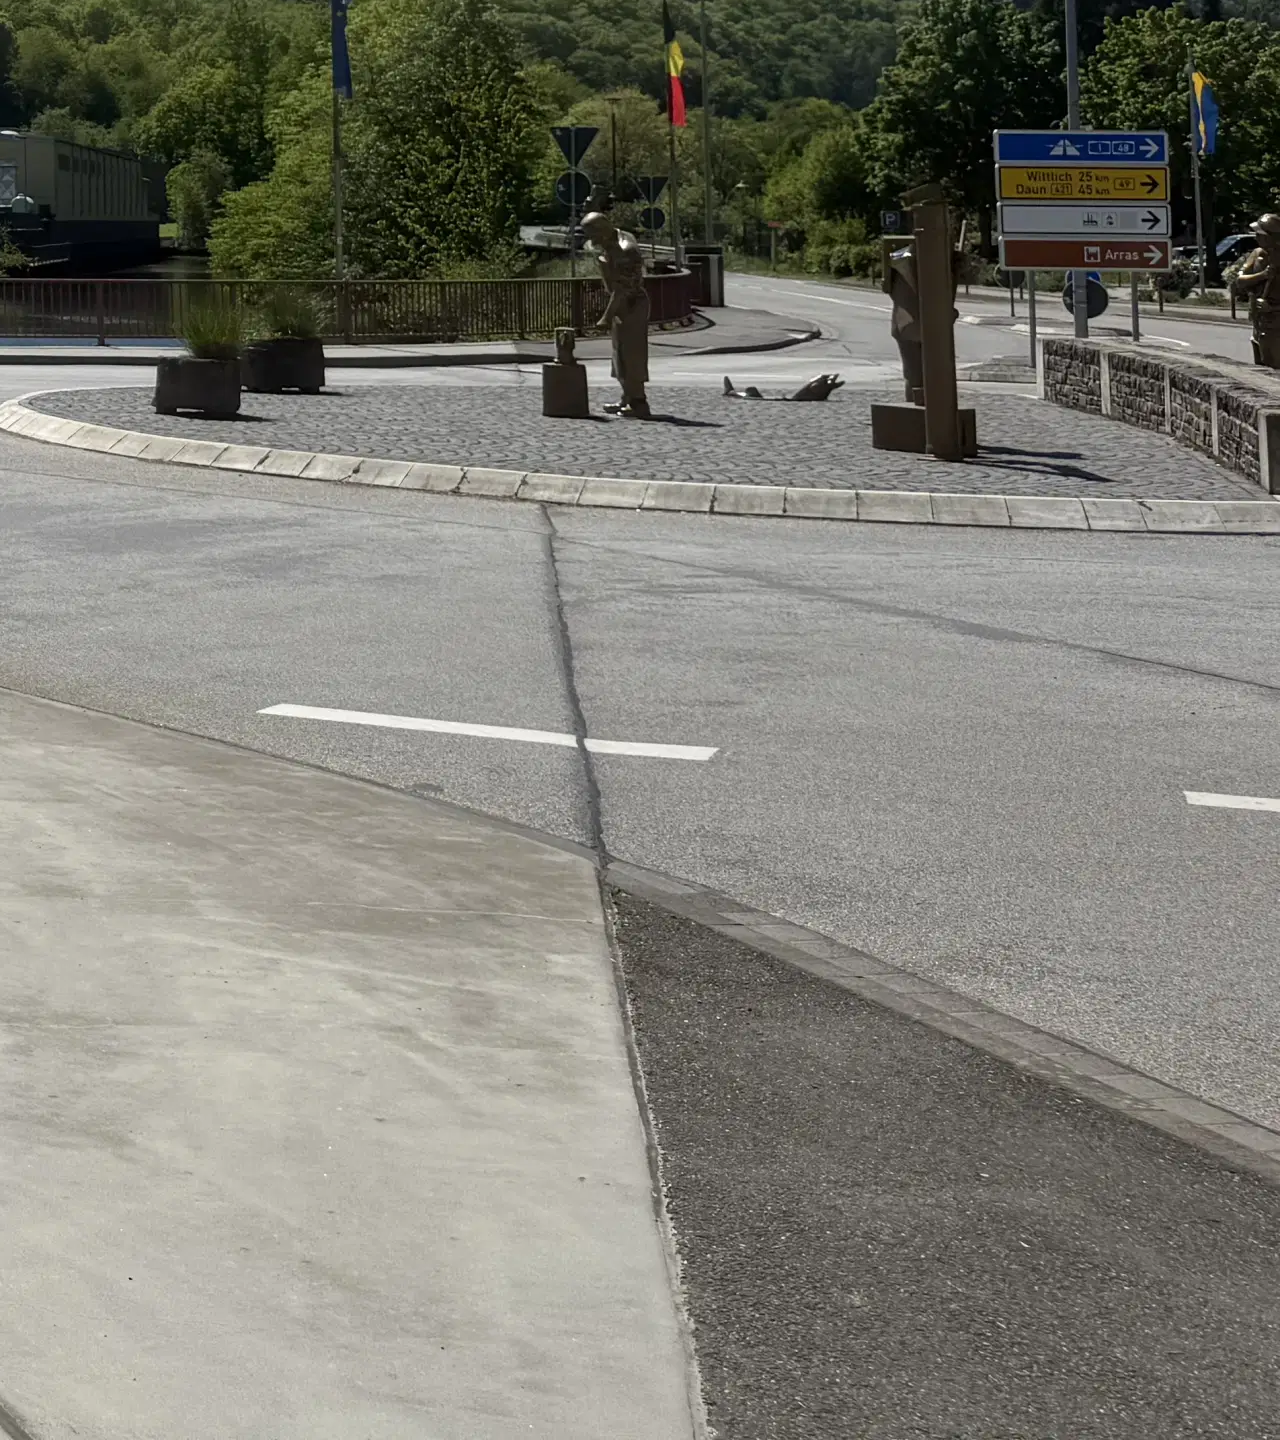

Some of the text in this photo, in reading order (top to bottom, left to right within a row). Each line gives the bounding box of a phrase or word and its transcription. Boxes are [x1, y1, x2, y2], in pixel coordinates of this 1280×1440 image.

[1117, 144, 1129, 153] 48
[1026, 171, 1110, 182] Wittlich 25 km
[1016, 184, 1046, 195] Daun
[1078, 184, 1093, 195] 45
[1095, 187, 1110, 195] km
[1104, 249, 1139, 260] Arras
